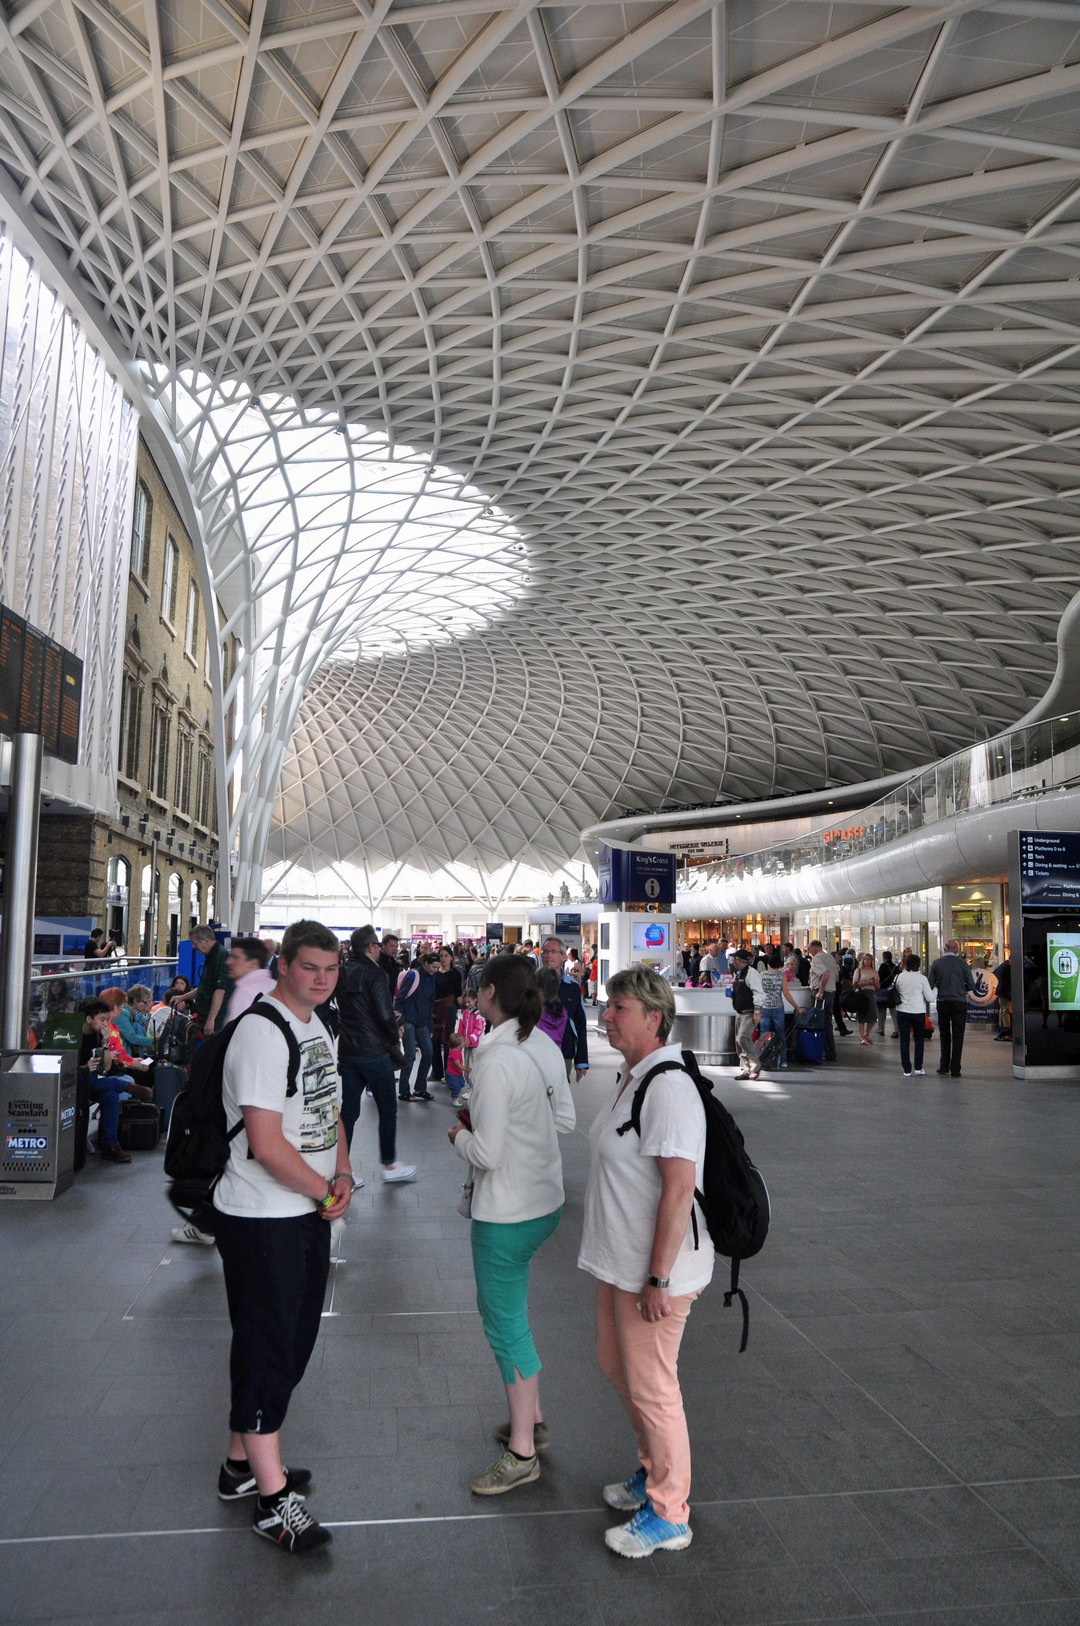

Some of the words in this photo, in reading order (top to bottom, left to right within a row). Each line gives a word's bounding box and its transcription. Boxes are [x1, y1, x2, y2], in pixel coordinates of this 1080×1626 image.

[8, 1101, 44, 1110] Evening
[8, 1108, 48, 1117] Standard
[60, 1106, 75, 1121] METRO
[8, 1137, 46, 1148] METRO
